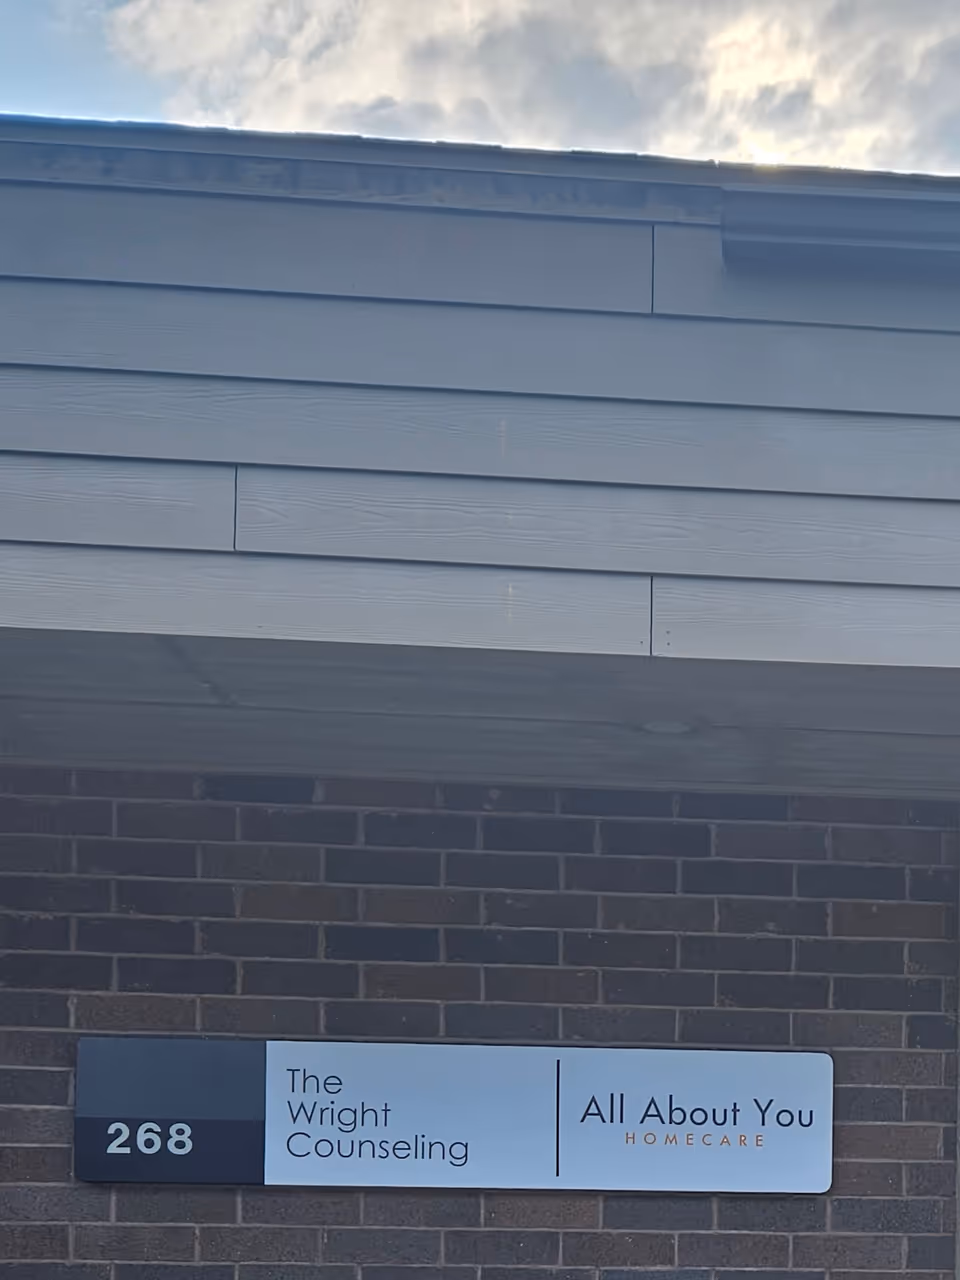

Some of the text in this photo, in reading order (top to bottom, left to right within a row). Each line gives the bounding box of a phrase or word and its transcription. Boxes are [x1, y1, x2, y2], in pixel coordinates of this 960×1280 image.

[286, 1068, 343, 1095] The
[286, 1100, 392, 1133] Wright
[579, 1093, 815, 1128] All About You
[105, 1122, 194, 1155] 268
[286, 1131, 469, 1167] Counseling
[625, 1132, 765, 1148] HOMECARE
